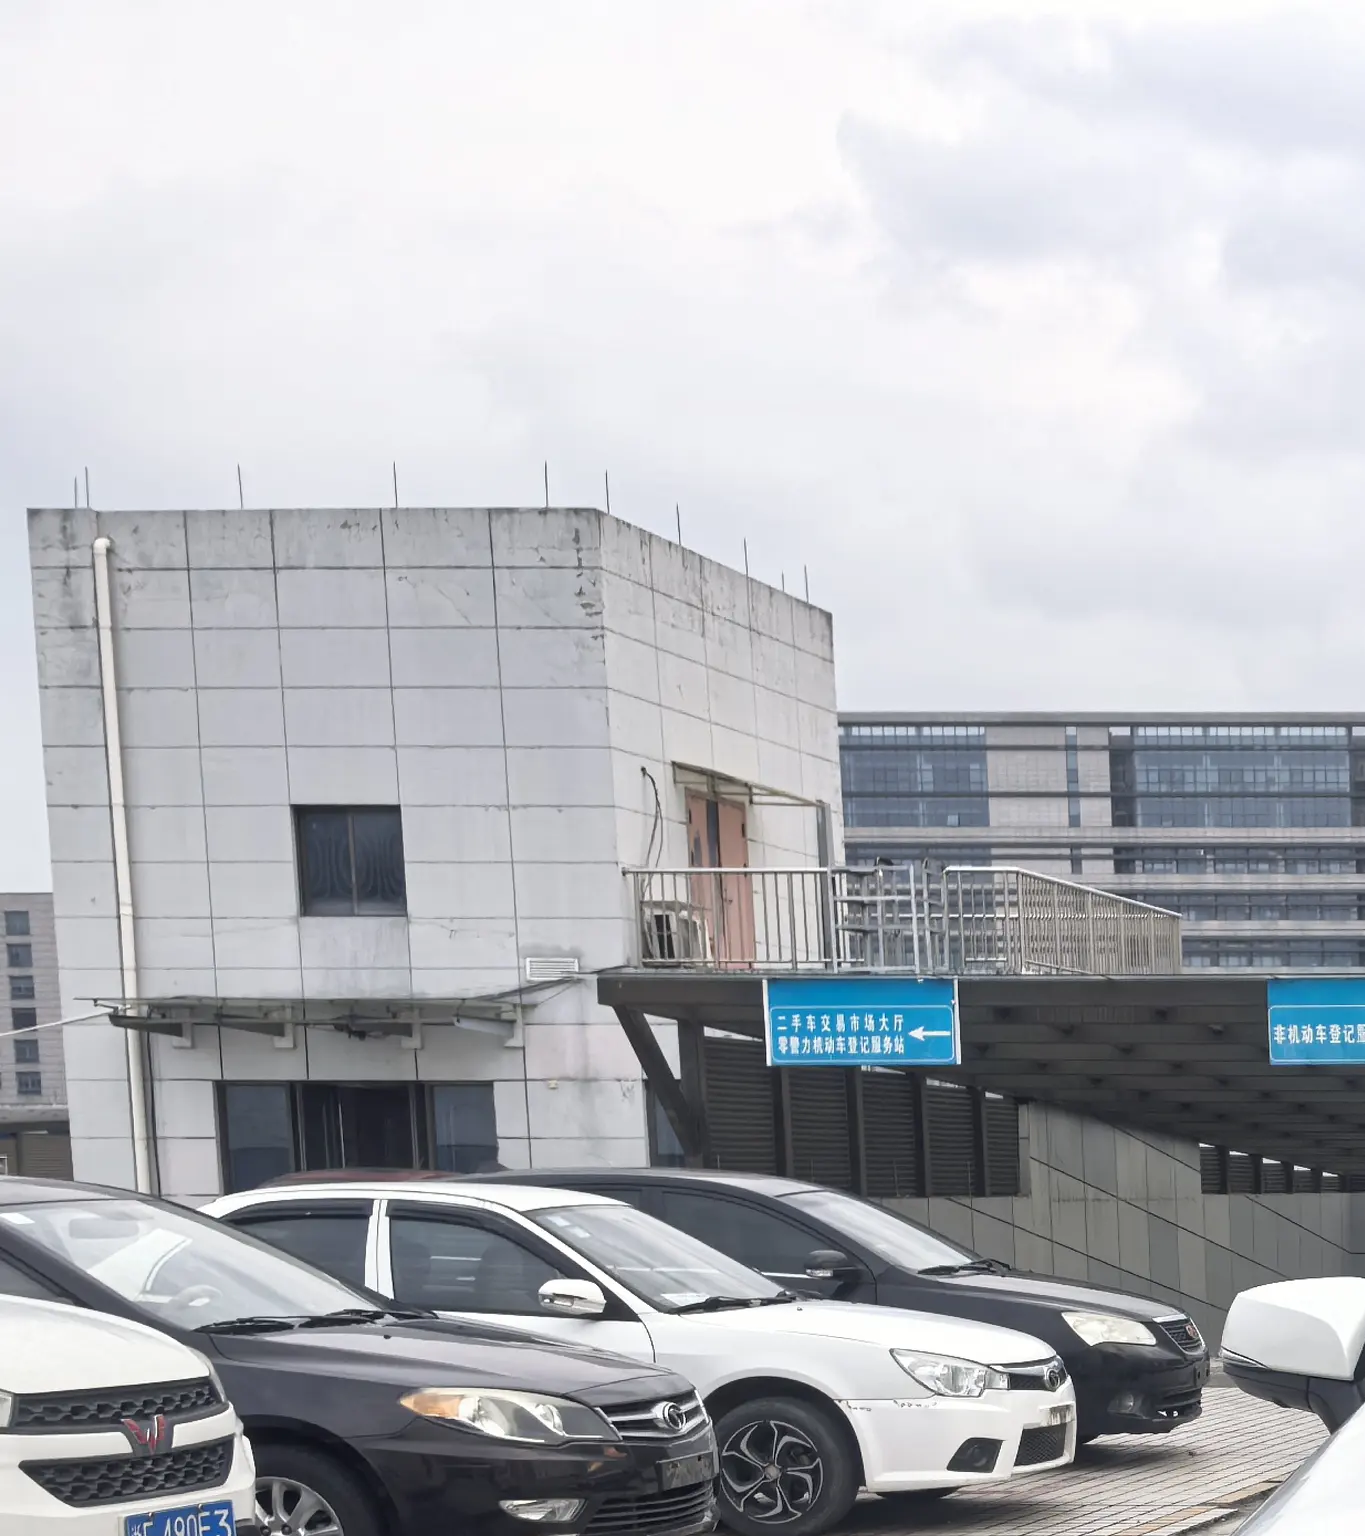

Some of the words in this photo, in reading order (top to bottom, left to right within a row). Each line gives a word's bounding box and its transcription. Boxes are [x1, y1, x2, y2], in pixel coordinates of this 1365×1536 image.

[777, 1012, 904, 1033] 二手车交易市场大厅
